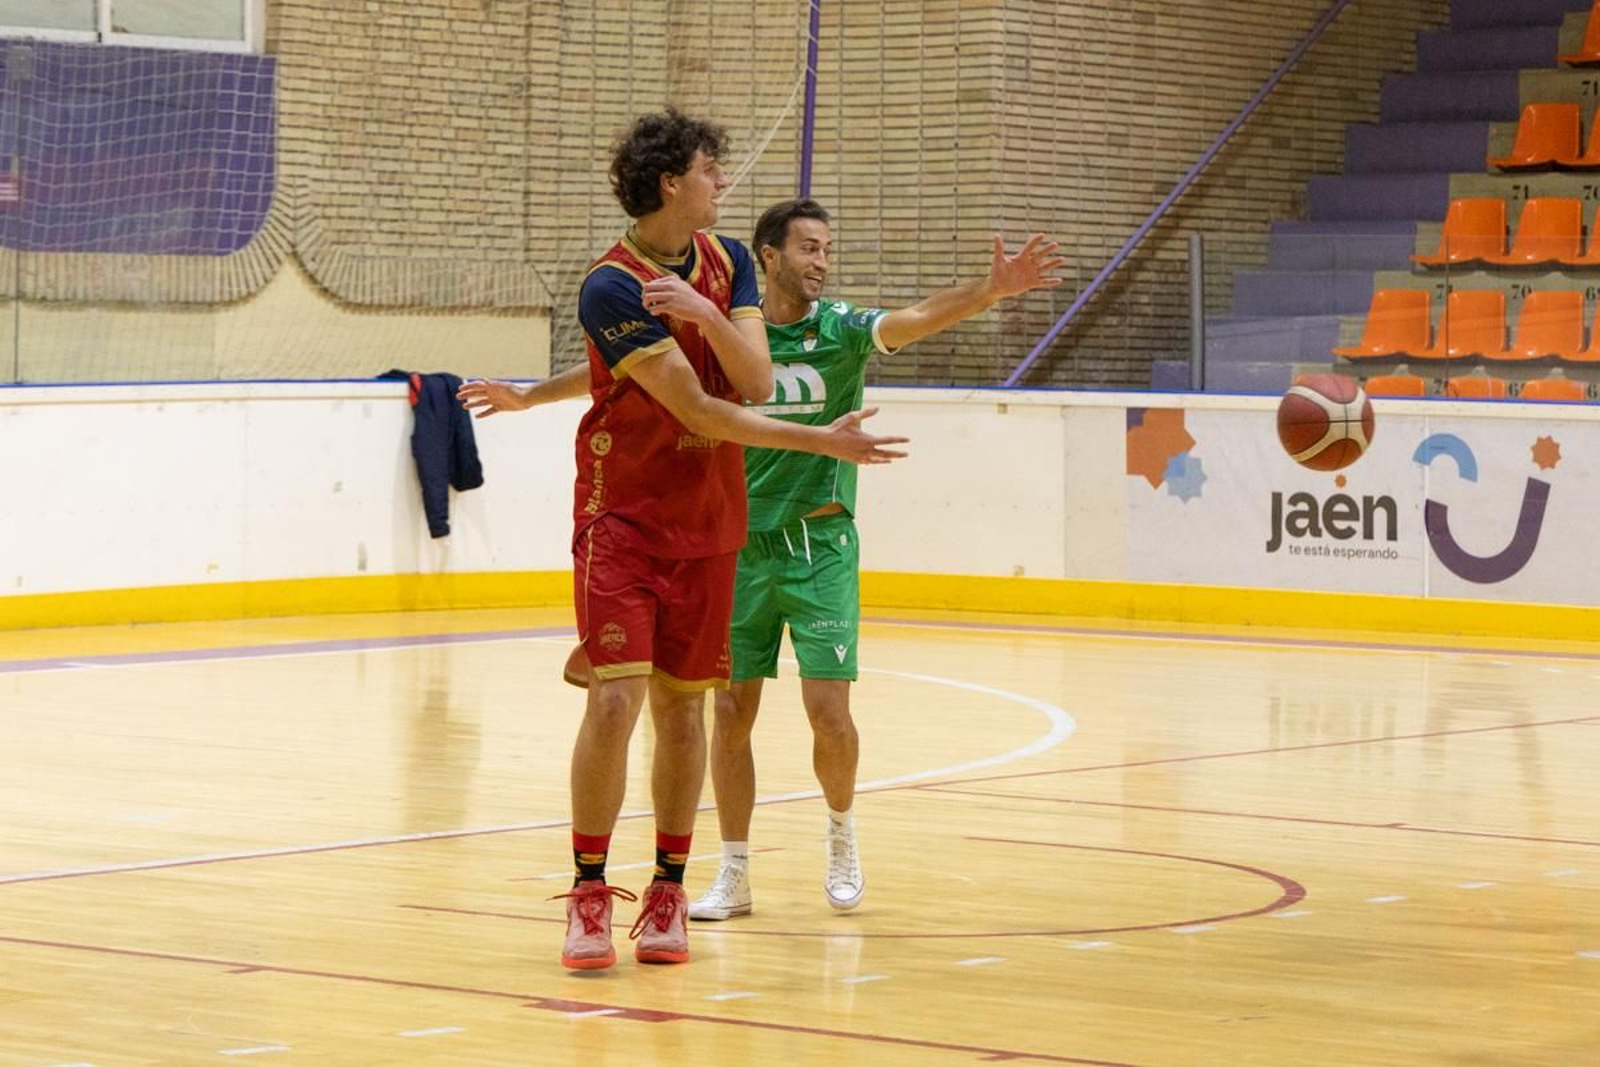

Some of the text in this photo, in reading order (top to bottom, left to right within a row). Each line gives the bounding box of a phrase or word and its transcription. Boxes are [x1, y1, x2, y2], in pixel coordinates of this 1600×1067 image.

[1582, 80, 1599, 96] 71
[1512, 184, 1529, 200] 71
[1289, 544, 1398, 560] te está esperando
